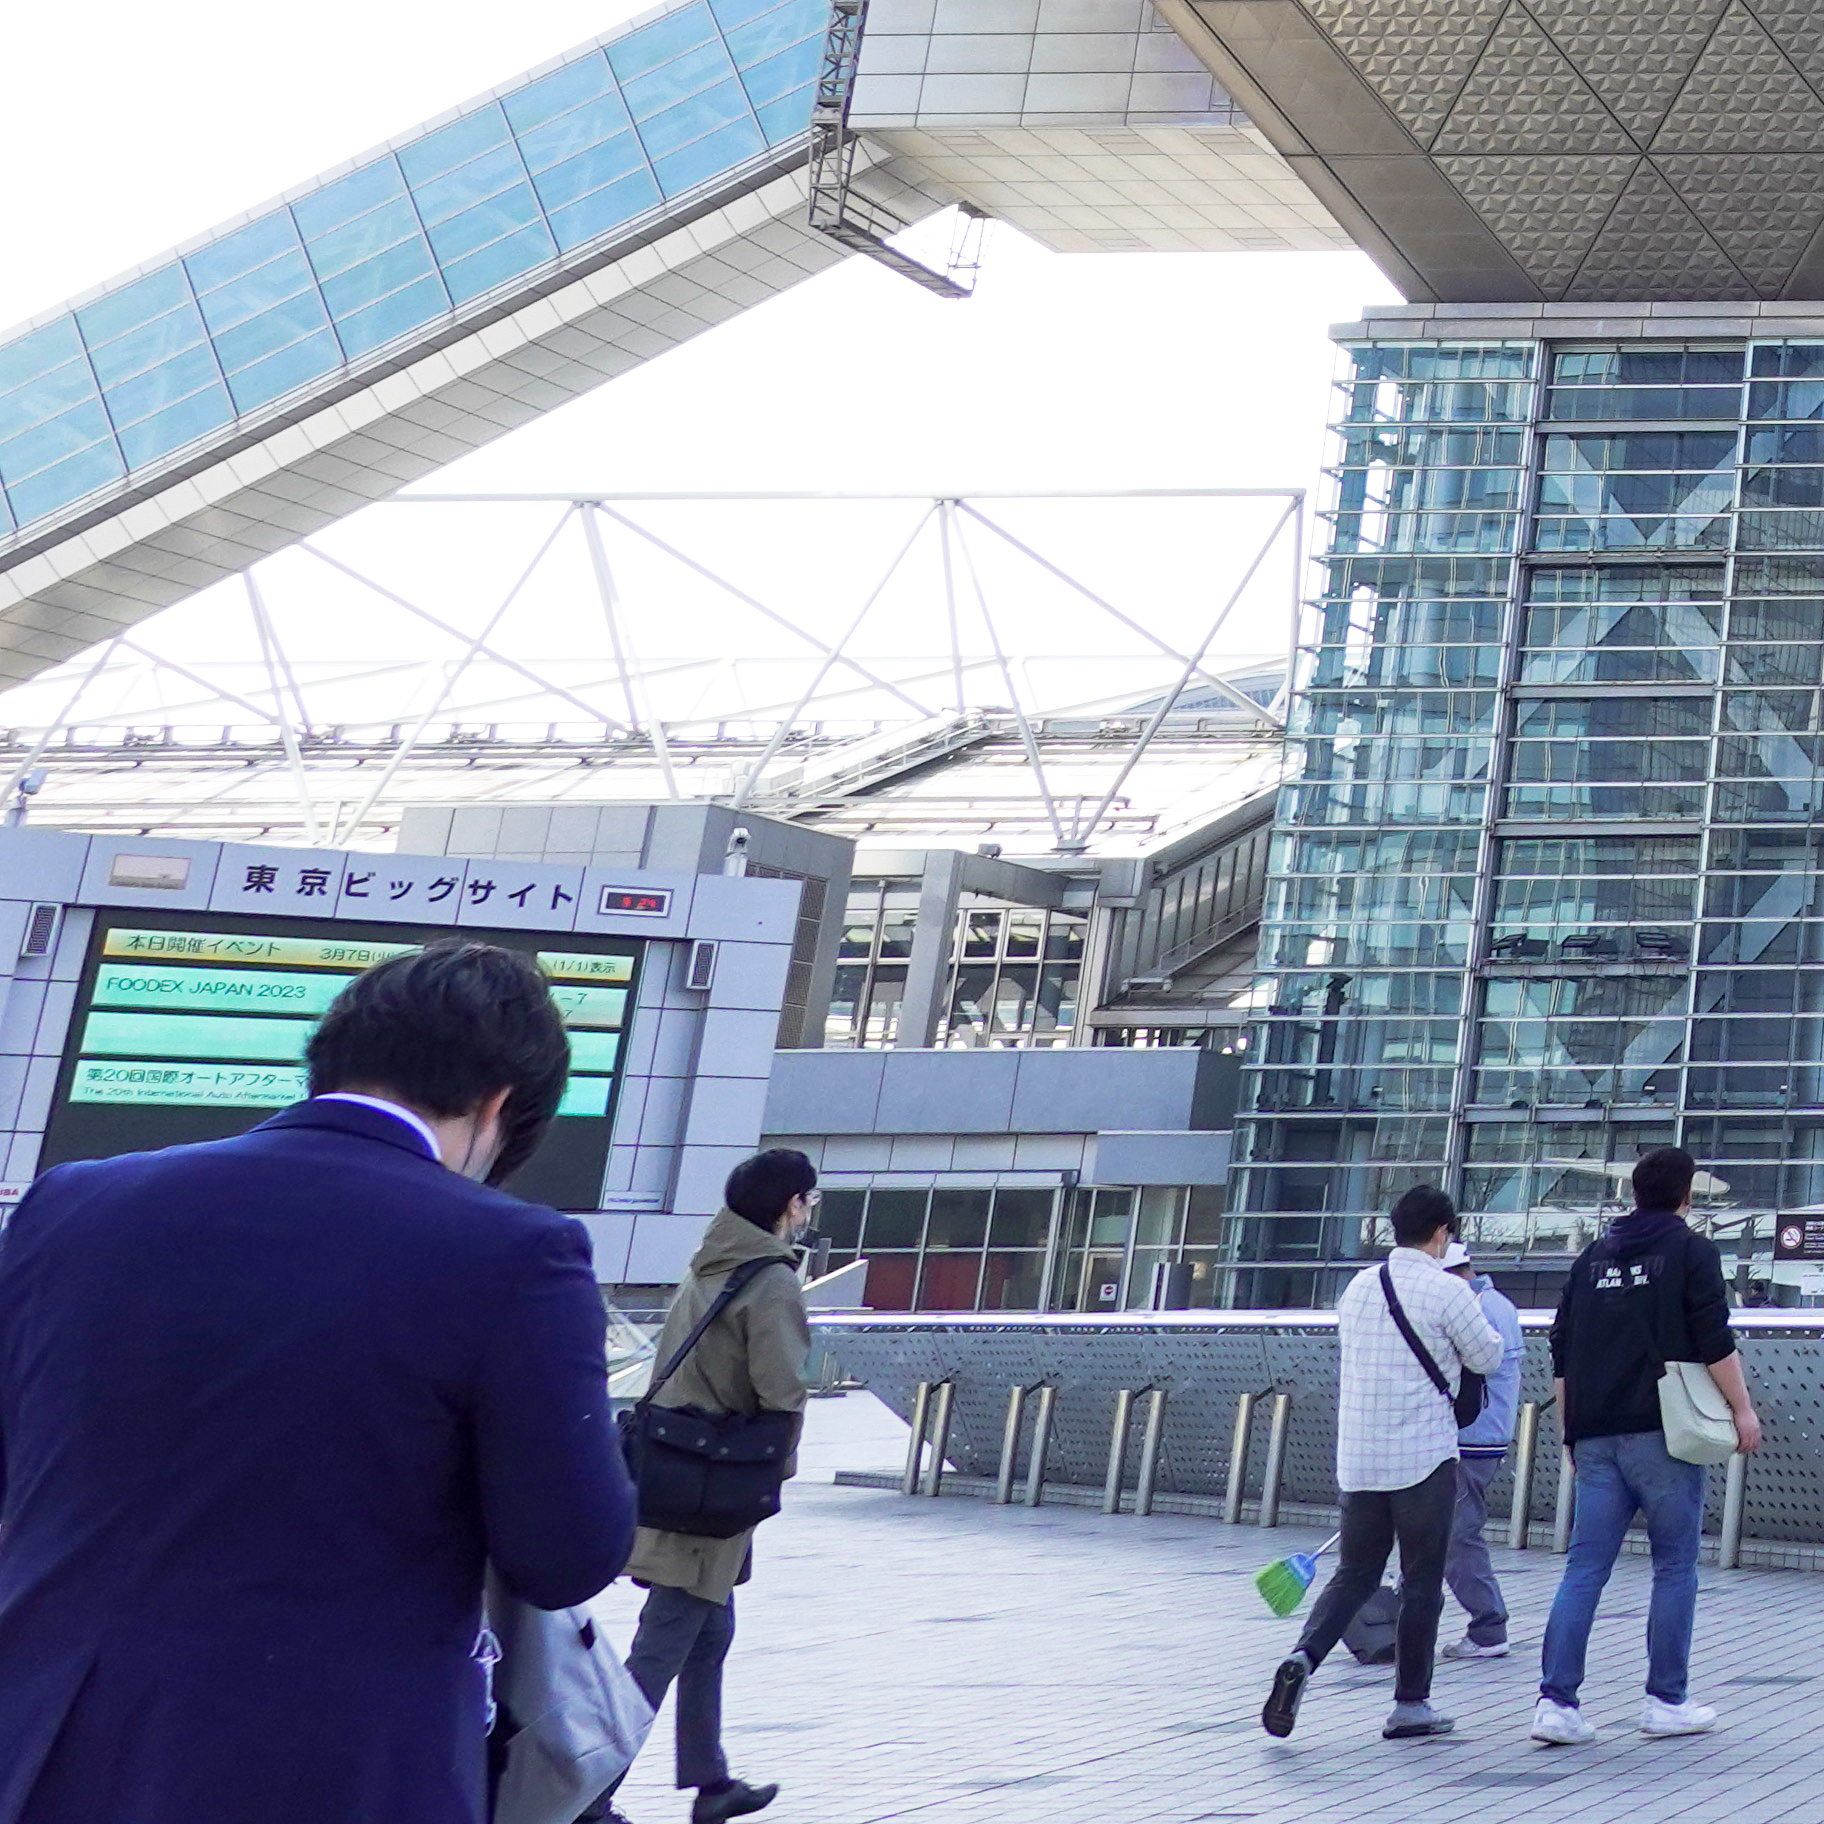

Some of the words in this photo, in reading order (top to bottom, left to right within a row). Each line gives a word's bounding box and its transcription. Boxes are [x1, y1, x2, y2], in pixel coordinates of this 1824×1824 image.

[242, 864, 573, 911] 東京ビッグサイト
[128, 934, 281, 957] 本日開催イベント
[107, 977, 183, 993] FOODEX
[189, 981, 253, 996] JAPAN
[257, 984, 307, 999] 2023
[86, 1068, 309, 1088] 第20回国際オートアフターマ
